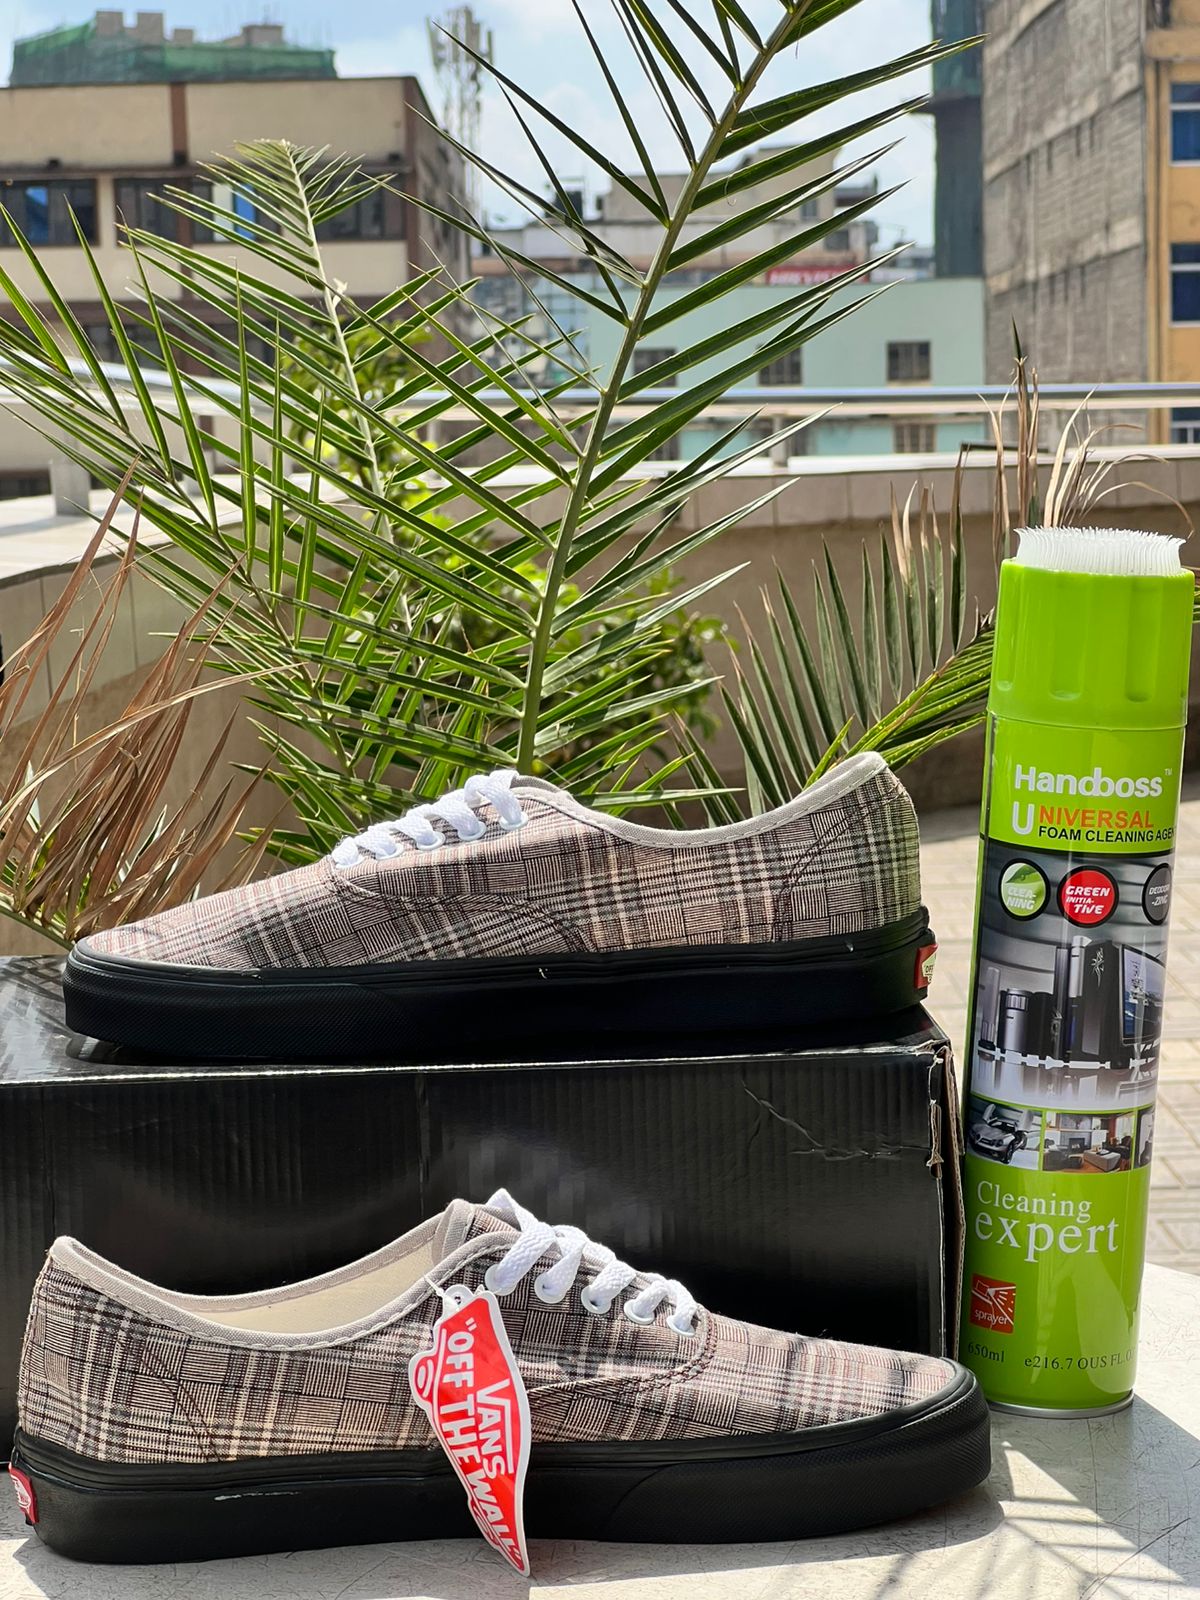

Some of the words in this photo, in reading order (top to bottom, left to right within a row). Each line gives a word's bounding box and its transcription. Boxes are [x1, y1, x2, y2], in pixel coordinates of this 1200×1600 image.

[1014, 764, 1163, 798] Handboss
[1011, 801, 1154, 835] UNIVERSAL
[1038, 825, 1081, 841] FOAM
[1085, 829, 1154, 843] CLEANING
[1065, 885, 1111, 897] GREEN
[1066, 896, 1095, 905] INITIA-
[1007, 897, 1035, 911] NING
[1073, 904, 1105, 915] TIVE
[977, 1180, 1092, 1224] Cleaning
[975, 1212, 1119, 1263] expert
[974, 1309, 1008, 1326] sprayer
[968, 1343, 1005, 1363] 650ml
[440, 1393, 480, 1467] THE
[475, 1378, 515, 1481] VANS
